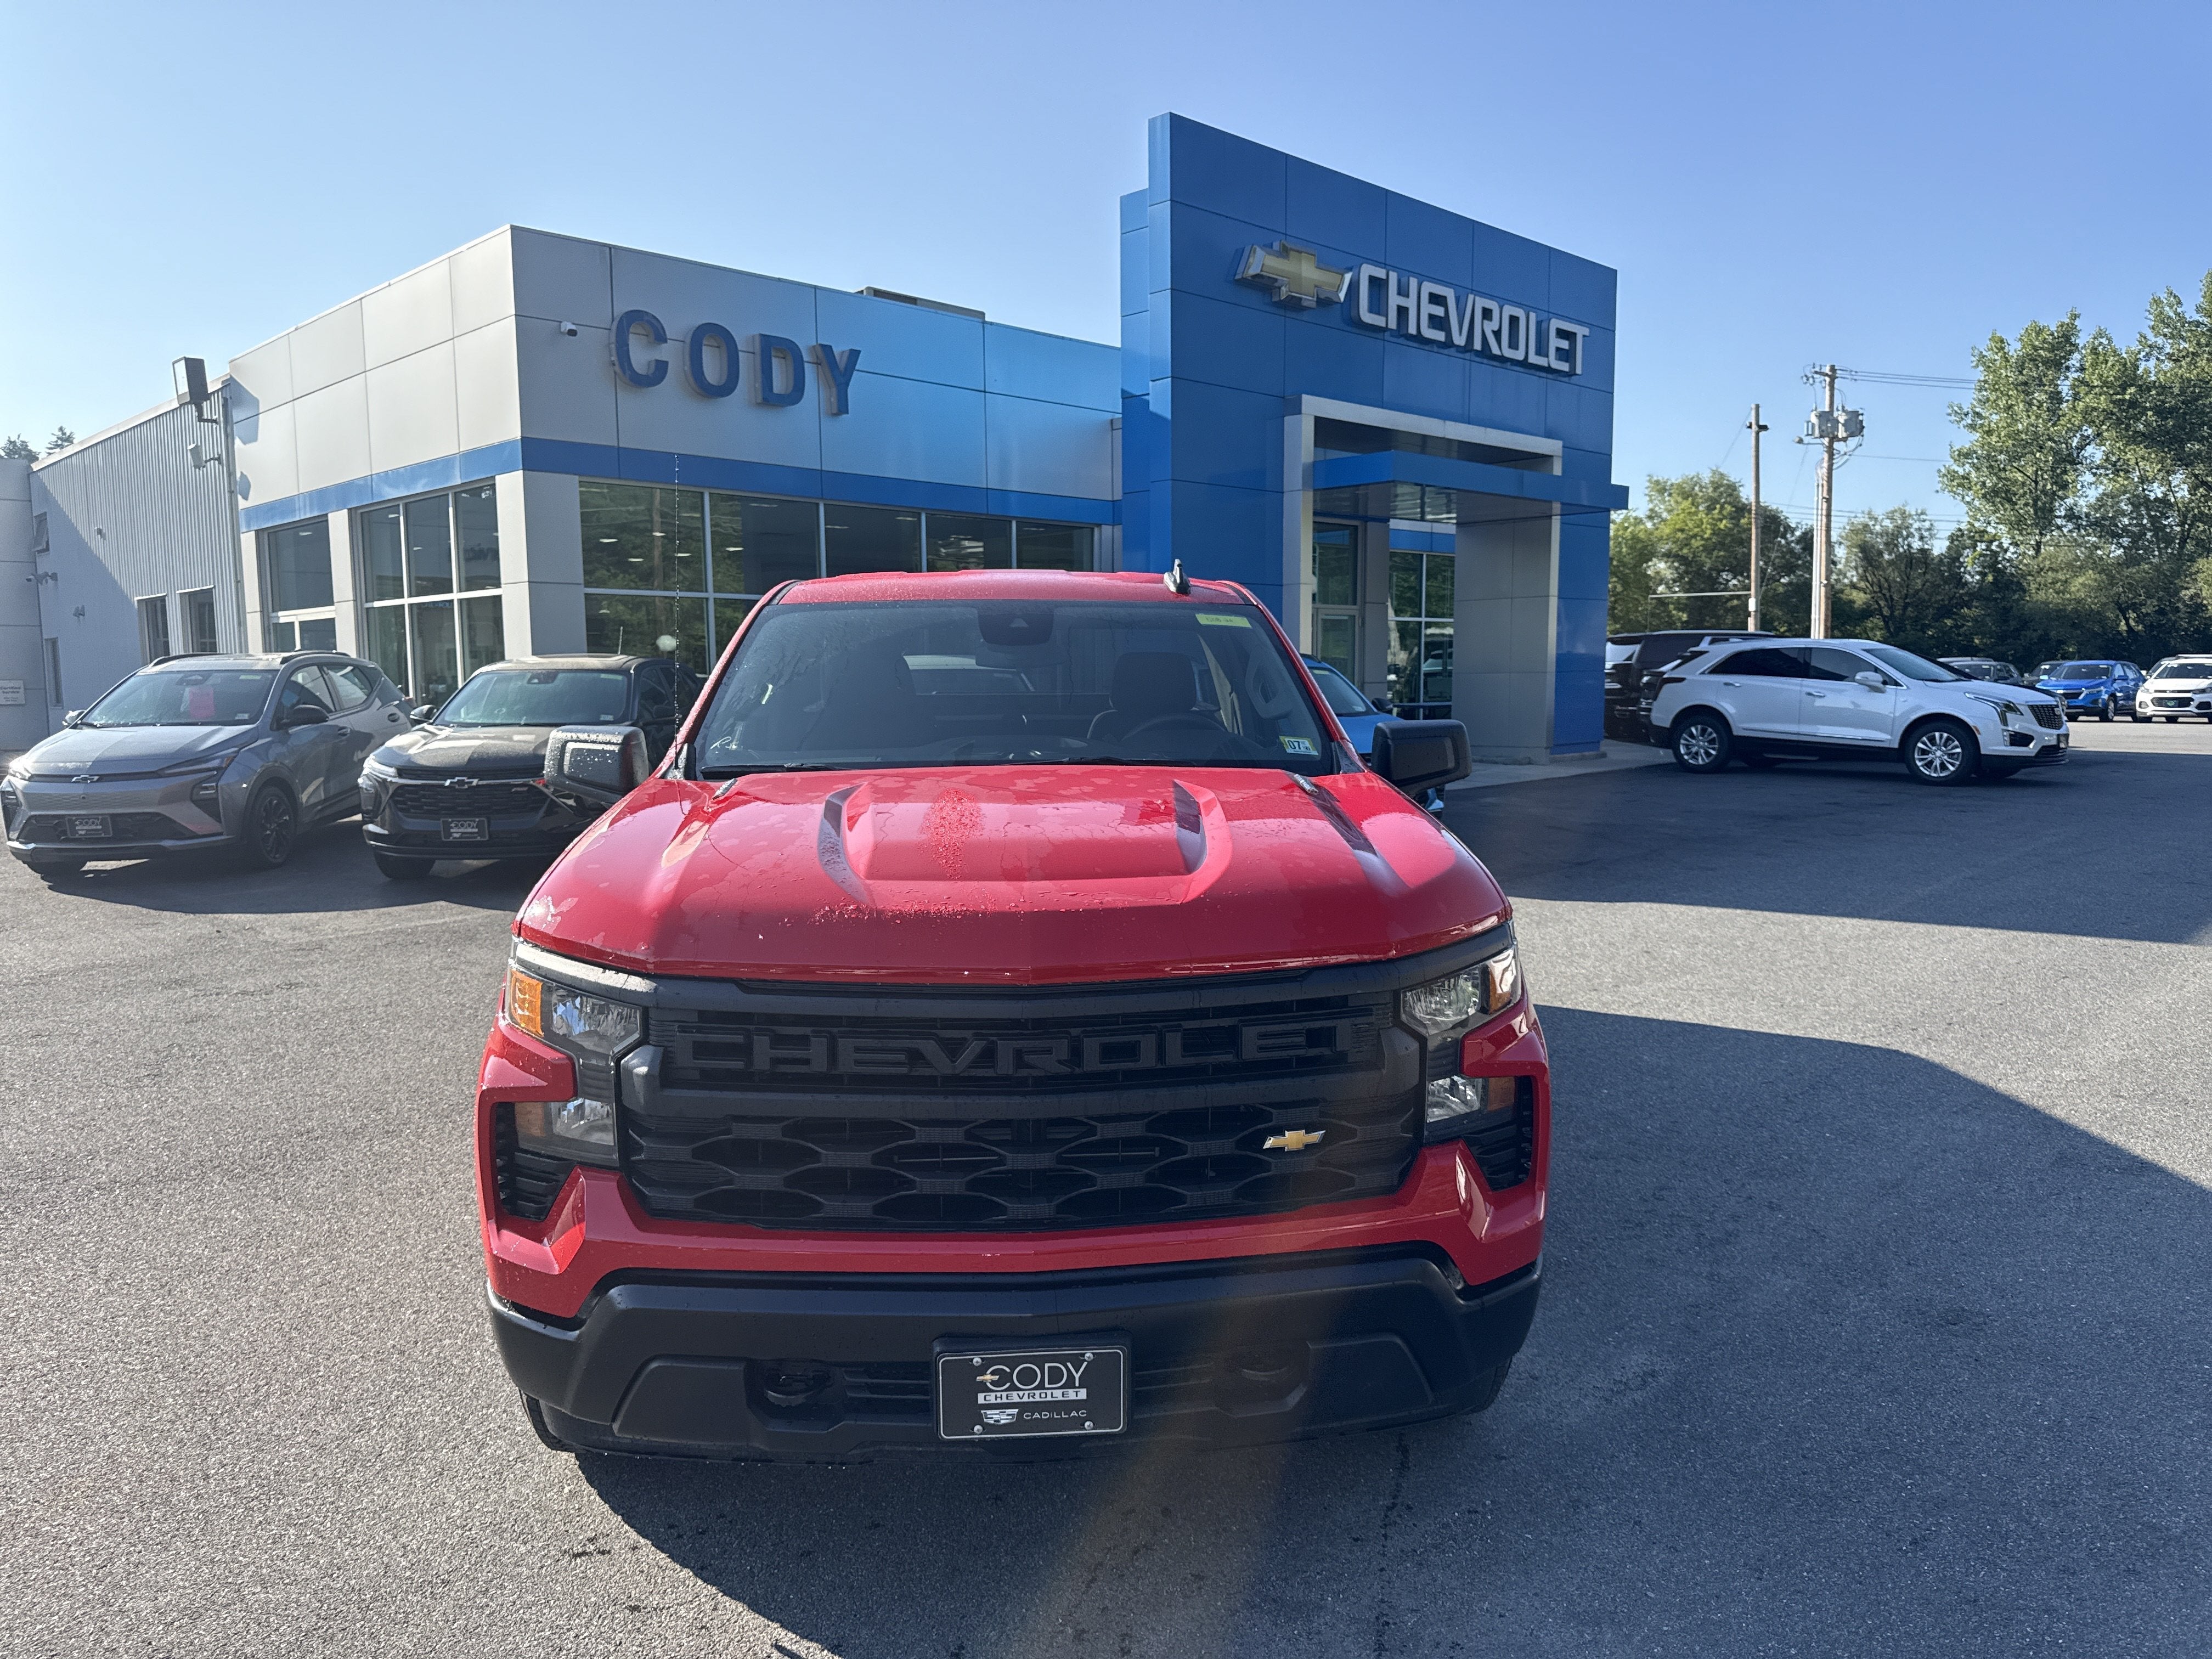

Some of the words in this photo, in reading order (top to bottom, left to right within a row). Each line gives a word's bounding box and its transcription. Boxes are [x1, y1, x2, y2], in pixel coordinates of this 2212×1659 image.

[1359, 263, 1589, 375] CHEVROLET
[610, 309, 861, 416] CODY
[1287, 740, 1301, 750] 07
[674, 1014, 1372, 1075] CHEVROLET
[985, 1362, 1088, 1390] CODY
[984, 1390, 1081, 1402] CHEVROLET
[1023, 1410, 1087, 1419] CADILLAC
